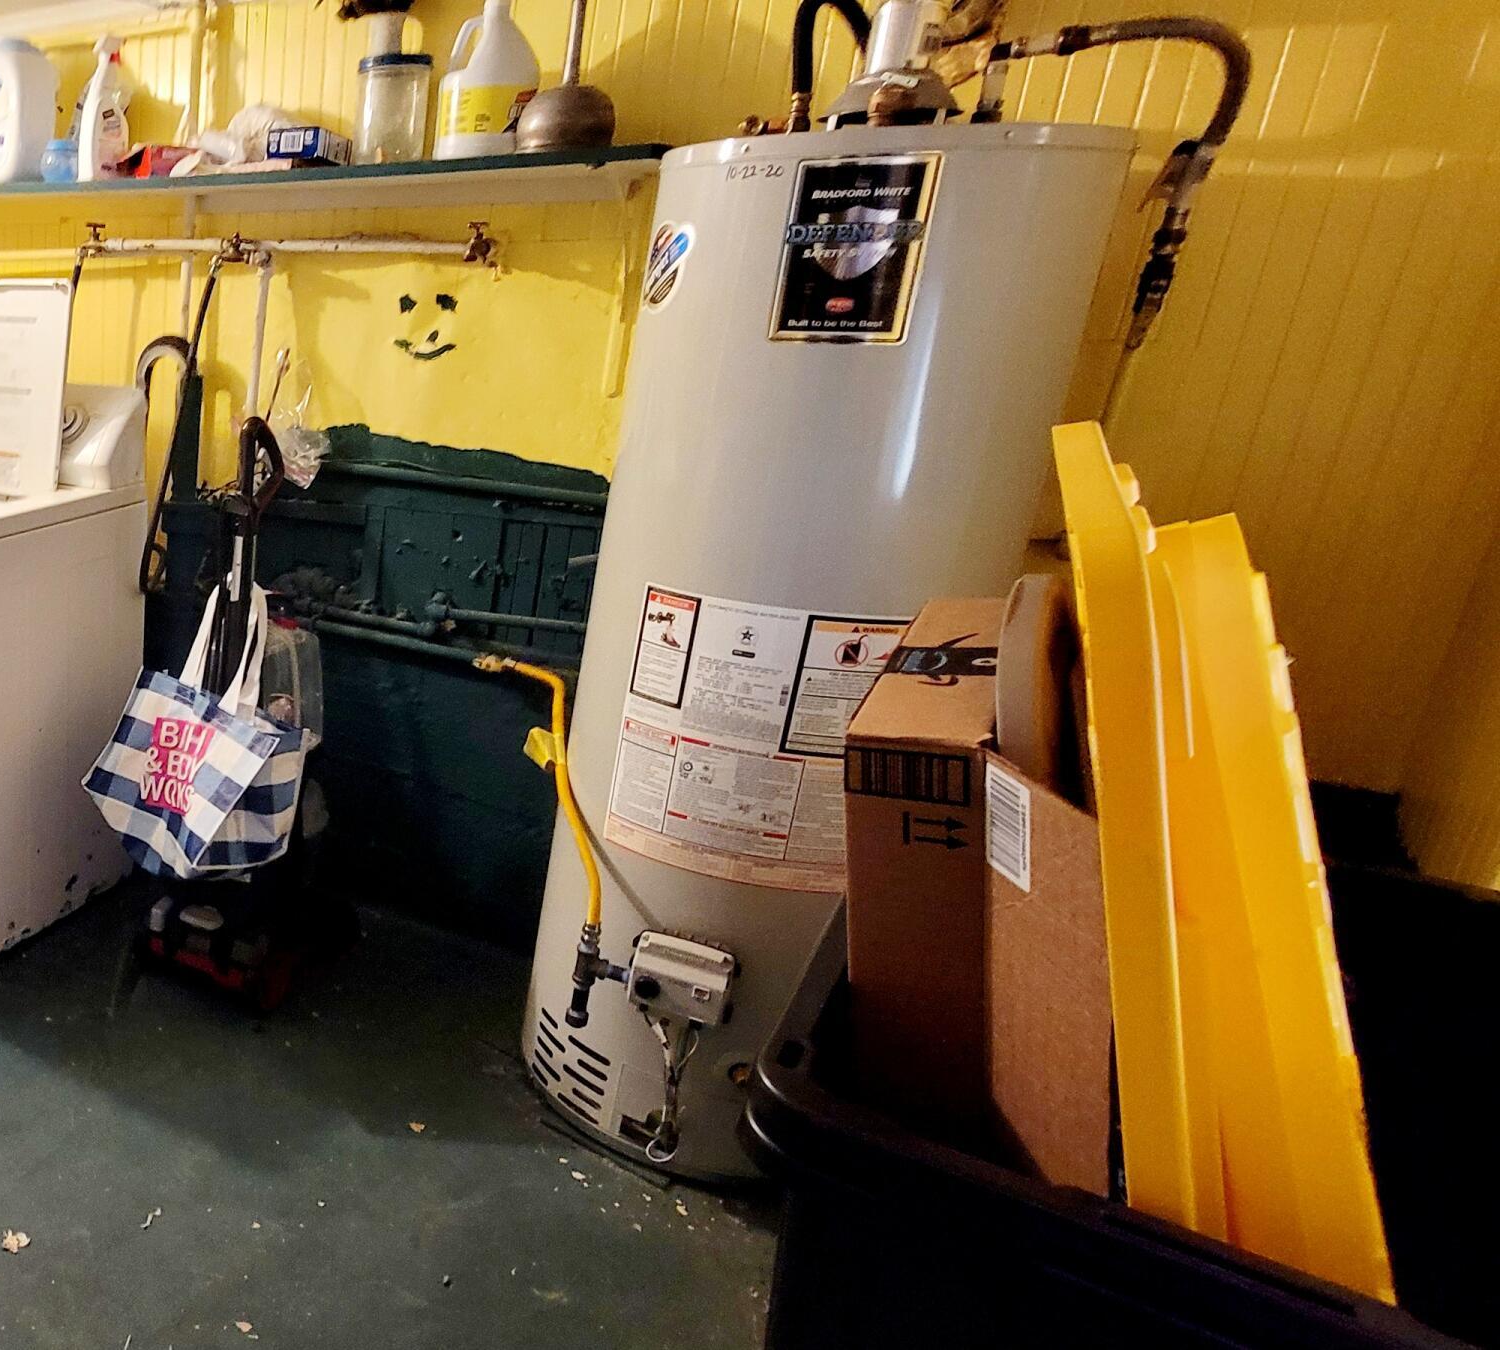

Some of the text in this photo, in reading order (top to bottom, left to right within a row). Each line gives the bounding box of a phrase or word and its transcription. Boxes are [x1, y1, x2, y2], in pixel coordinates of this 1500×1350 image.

[811, 187, 912, 200] BRADFORD WHITE
[787, 319, 883, 327] Built to be the Best
[145, 747, 163, 774] &
